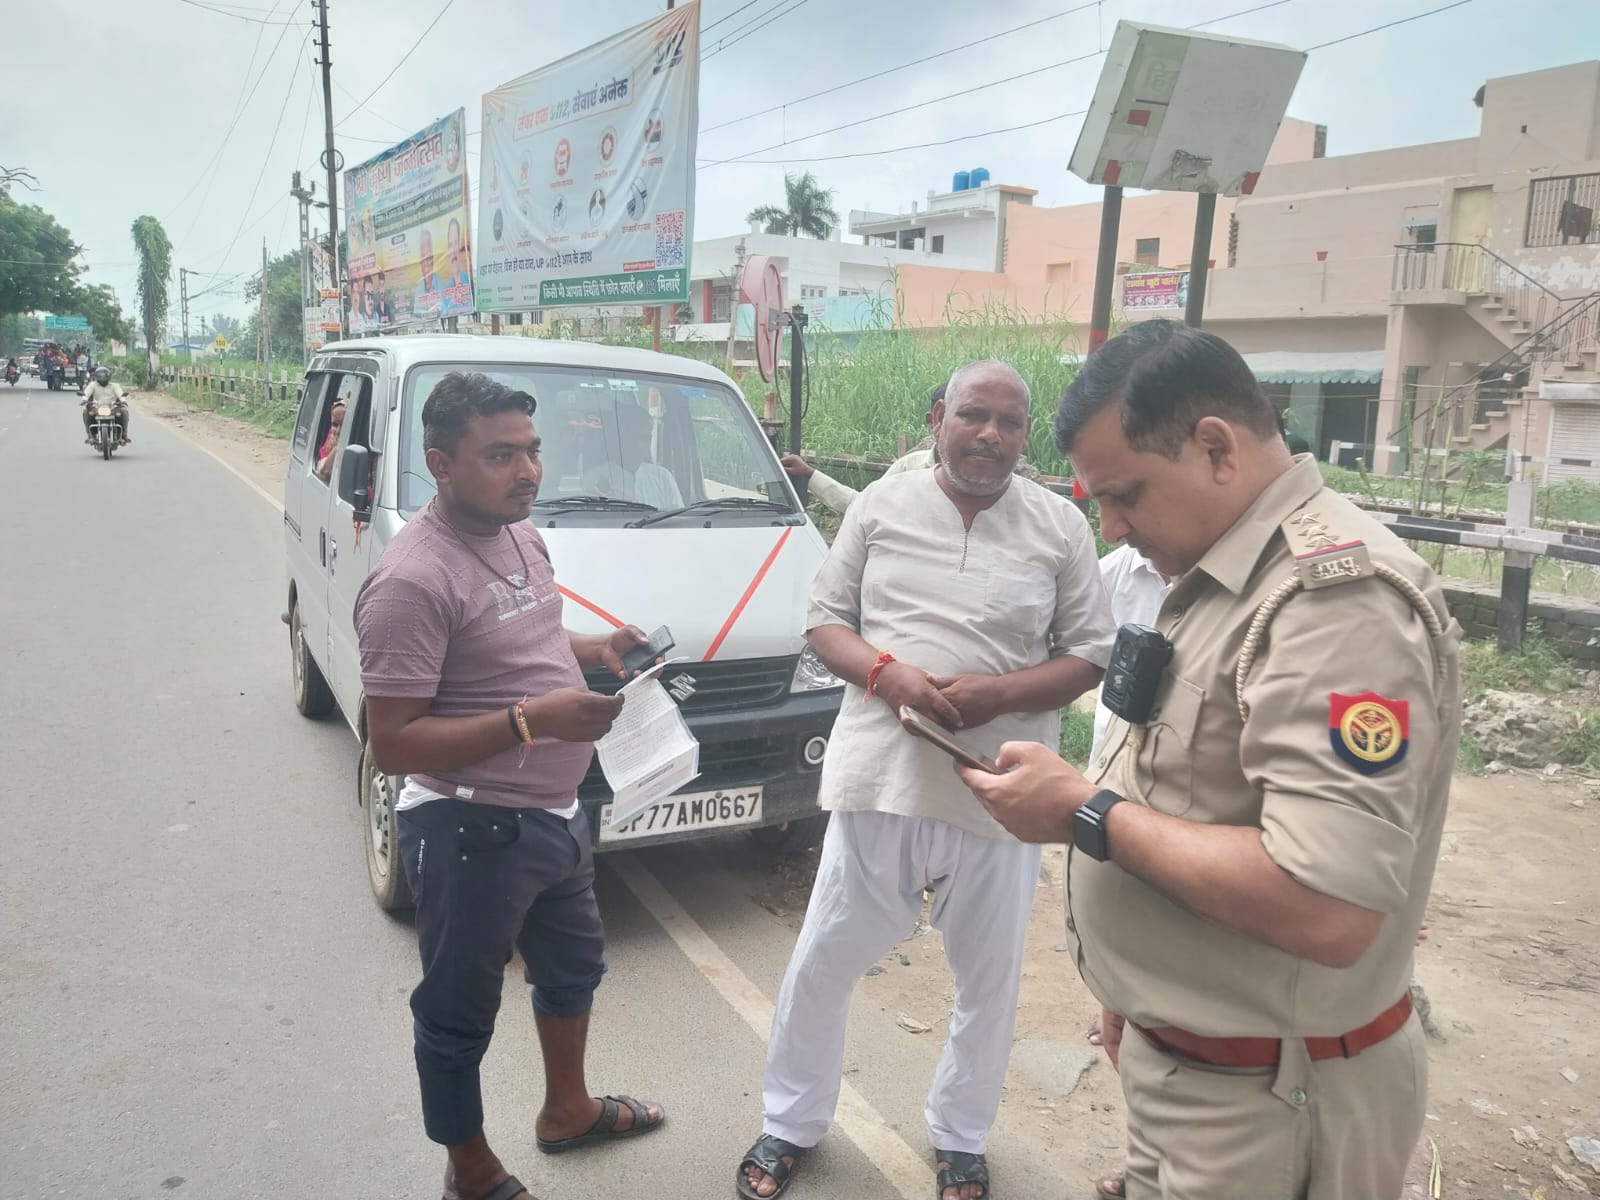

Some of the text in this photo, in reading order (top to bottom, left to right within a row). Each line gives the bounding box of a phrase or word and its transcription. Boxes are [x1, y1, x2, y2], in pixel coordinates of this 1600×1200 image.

[572, 82, 598, 114] सेवाएं
[599, 77, 629, 104] अनेक
[536, 258, 545, 269] UP
[543, 283, 558, 299] किसी
[558, 282, 566, 297] भी
